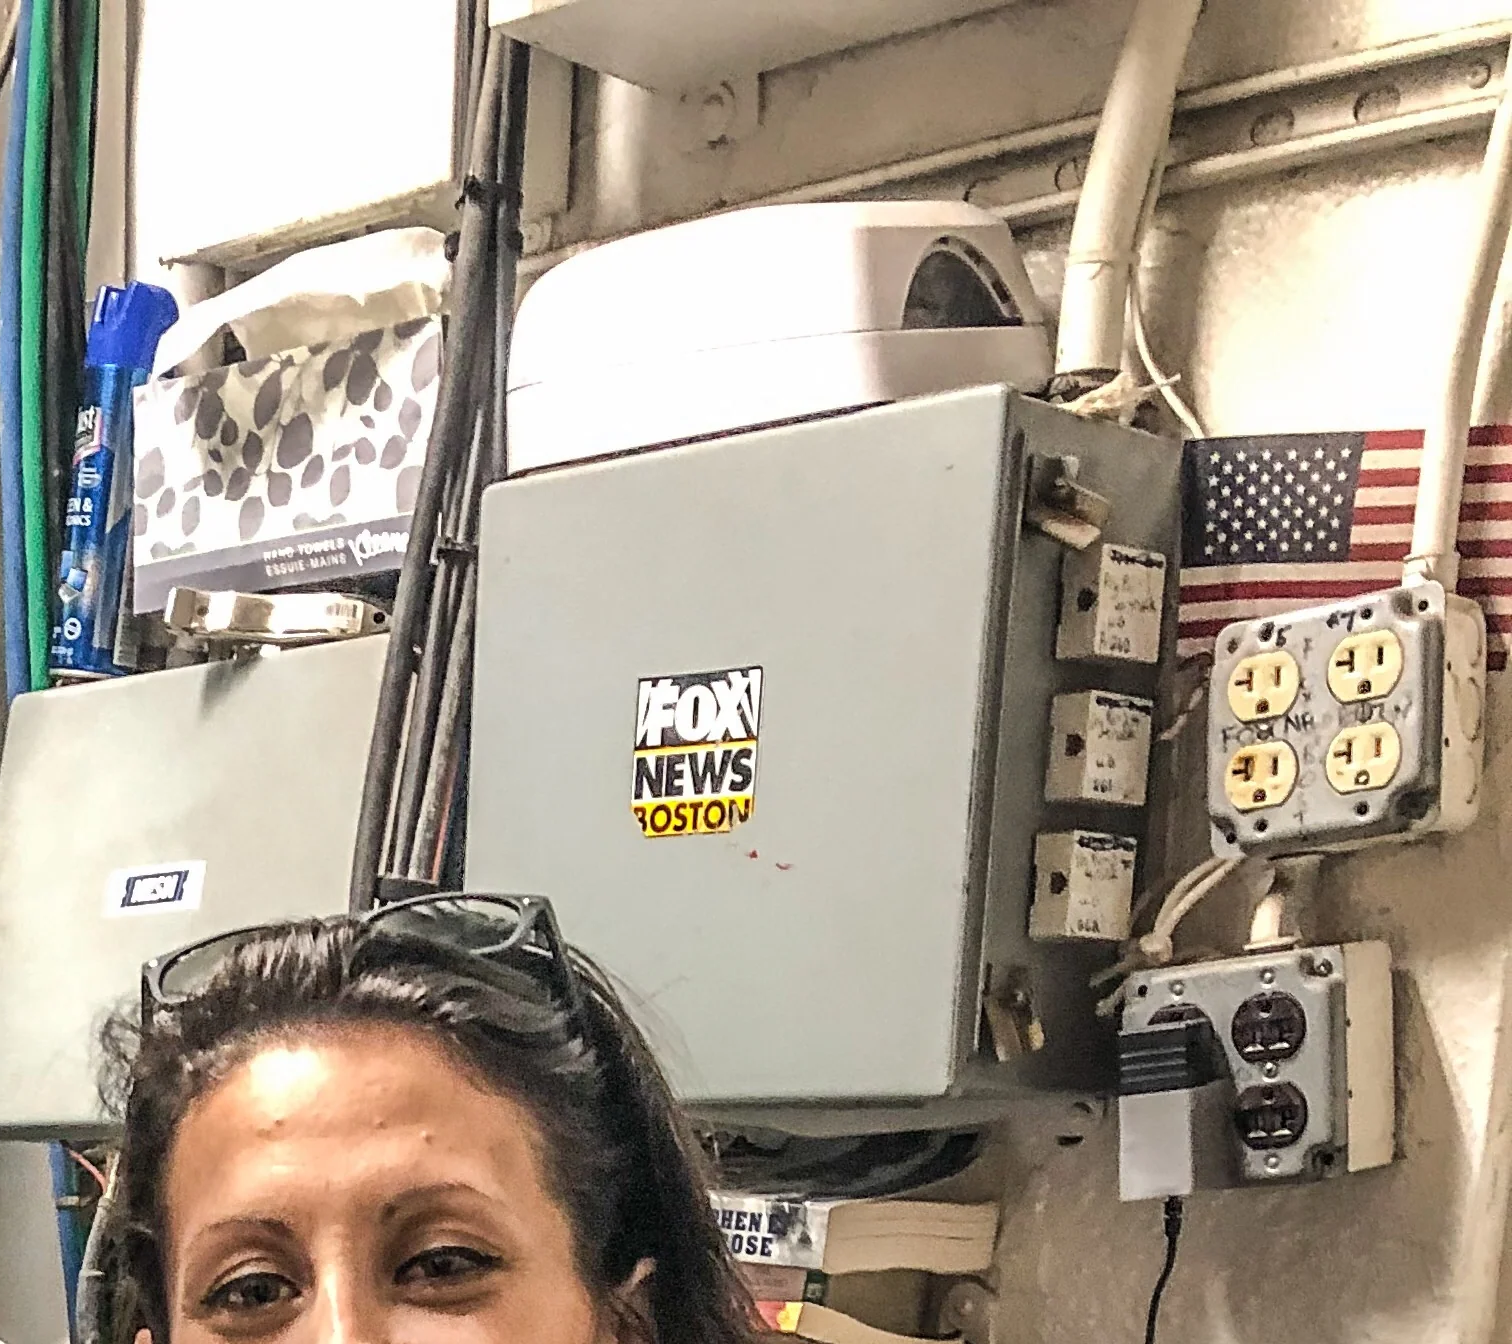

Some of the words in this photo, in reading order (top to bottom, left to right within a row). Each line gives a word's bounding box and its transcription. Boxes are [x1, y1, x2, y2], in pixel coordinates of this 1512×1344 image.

[297, 537, 345, 556] TOWELS
[265, 552, 347, 577] ESSUIE-MAINS
[642, 670, 754, 746] FOX
[634, 747, 753, 800] NEWS
[633, 798, 751, 832] BOSTON
[714, 1208, 763, 1233] HEN
[731, 1233, 773, 1257] OSE
